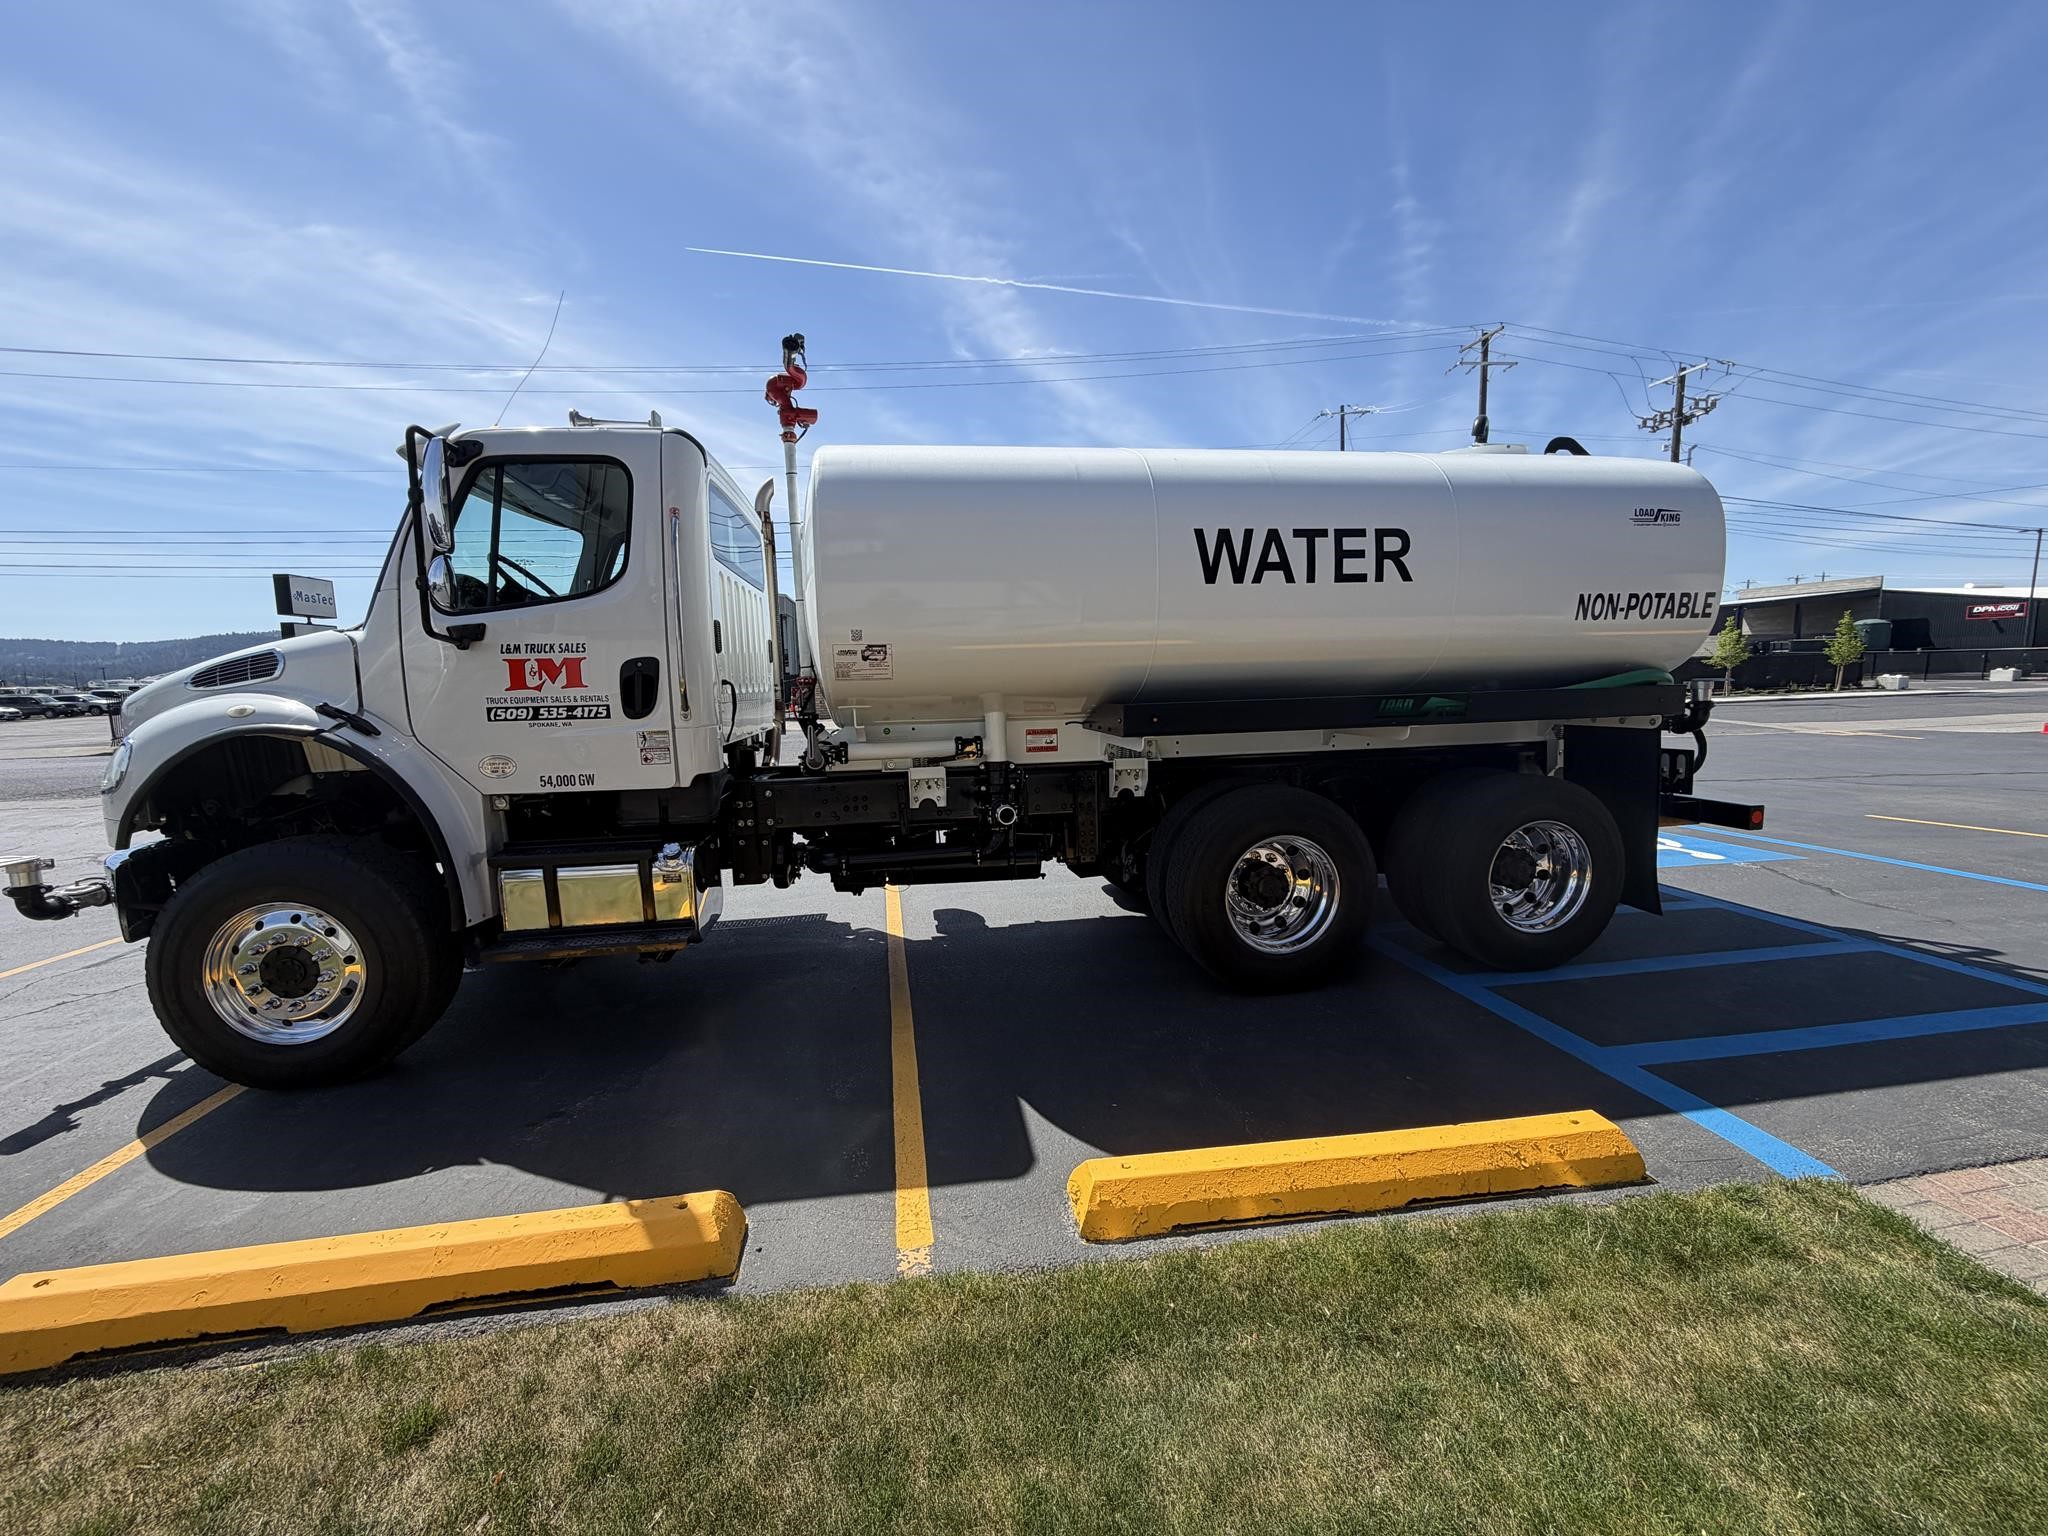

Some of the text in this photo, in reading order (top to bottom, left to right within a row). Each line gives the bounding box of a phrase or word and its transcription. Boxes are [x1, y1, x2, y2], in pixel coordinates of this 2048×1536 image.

[1634, 508, 1681, 522] LOAD KING
[1193, 528, 1414, 585] WATER
[296, 590, 334, 606] MasTec
[1574, 591, 1717, 621] NON-POTABLE
[500, 642, 587, 654] L&M TRUCK SALES
[485, 694, 610, 705] TRUCK EQUIPMENT SALES & RENTALS
[490, 706, 608, 721] (509) 535-4175
[539, 774, 595, 788] 54,000 GW
